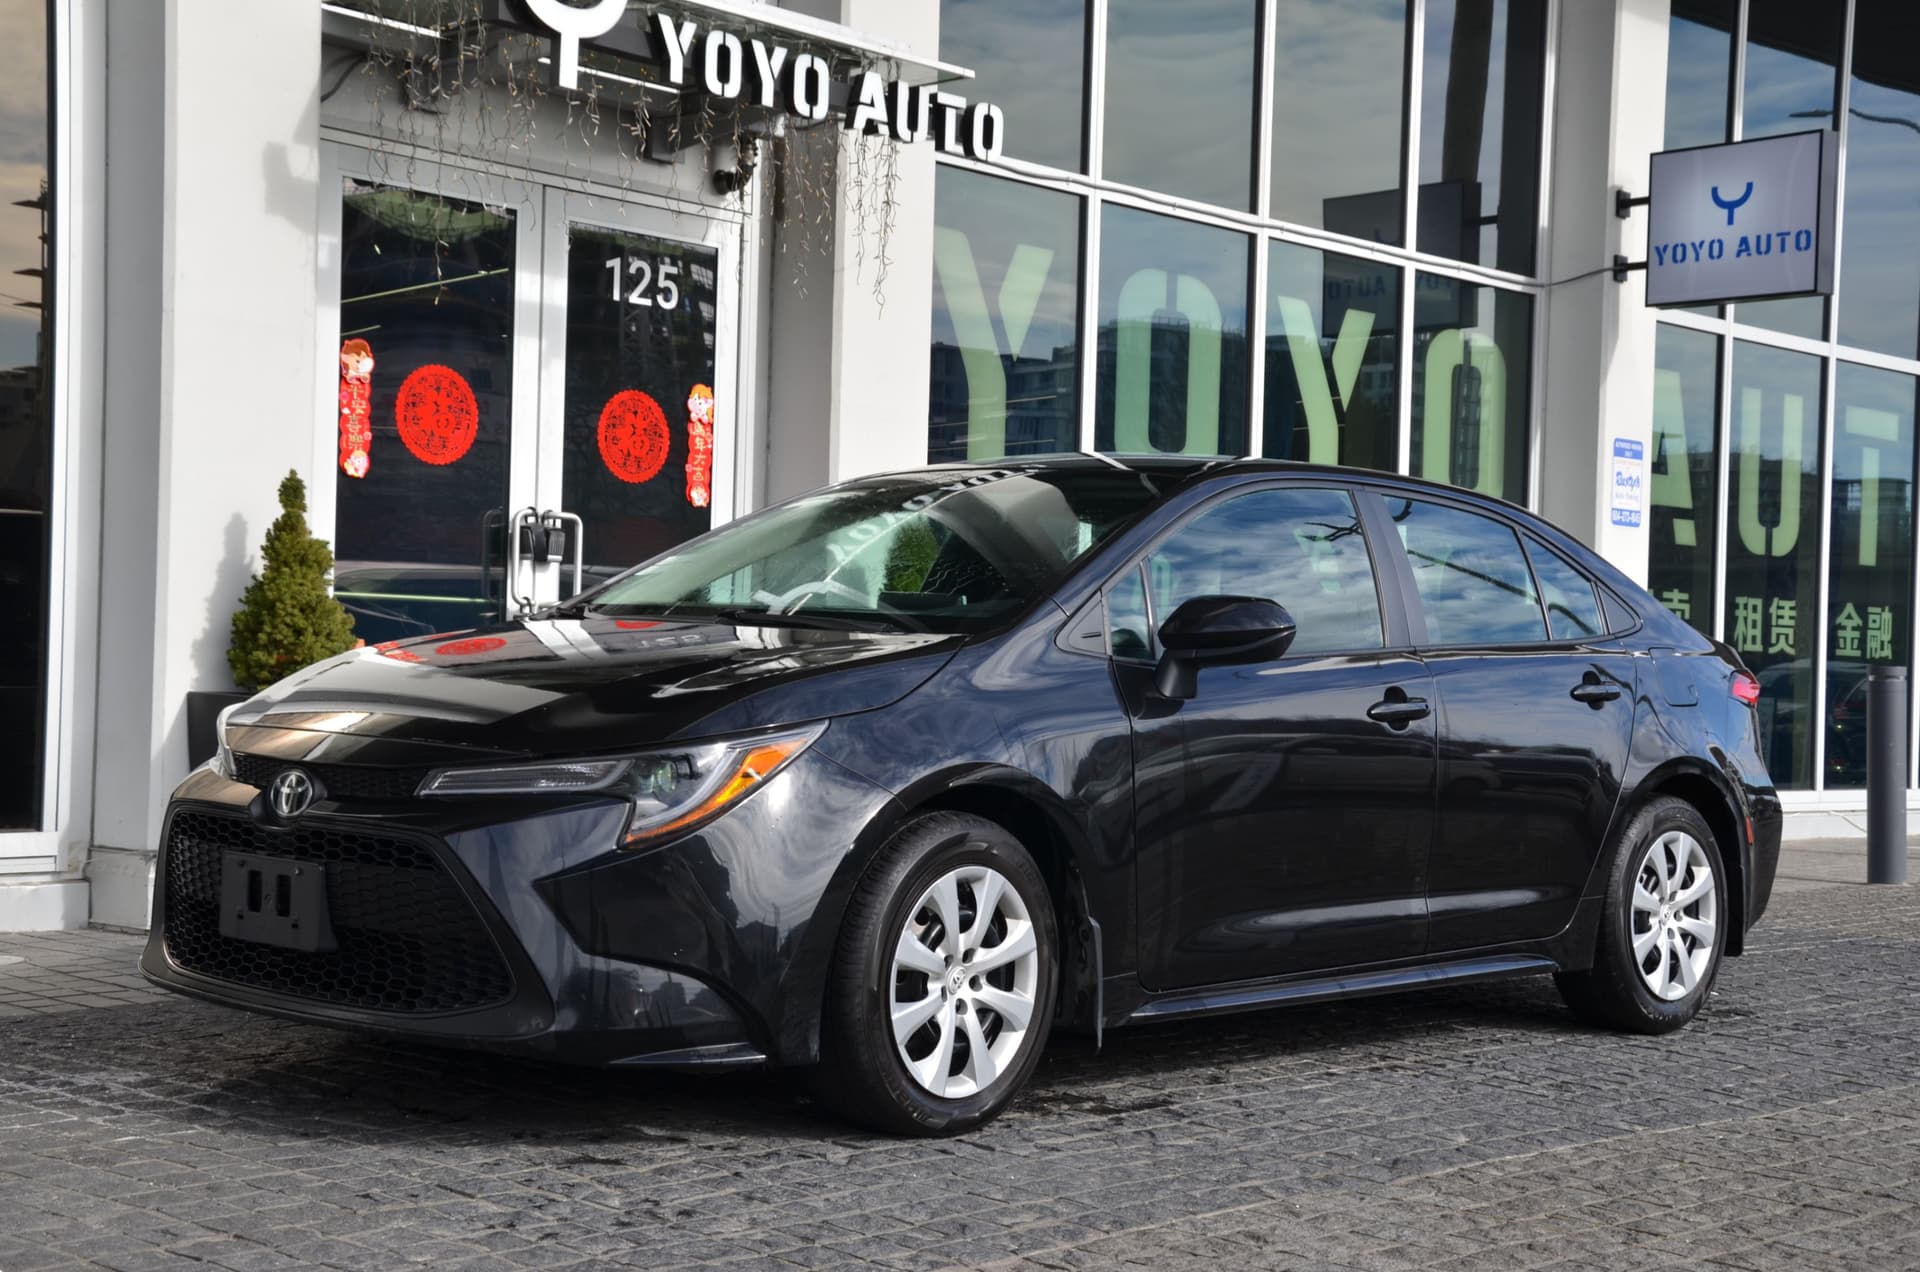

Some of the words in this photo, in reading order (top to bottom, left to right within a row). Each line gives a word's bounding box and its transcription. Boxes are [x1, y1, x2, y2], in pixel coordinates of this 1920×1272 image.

[657, 13, 830, 120] YOYO
[853, 71, 1004, 161] AUTO
[1654, 238, 1724, 266] YOYO
[1736, 229, 1812, 258] AUTO
[605, 256, 679, 310] 125
[934, 225, 1507, 499] YOYO
[1734, 597, 1797, 655] 租赁
[1836, 602, 1893, 659] 金融
